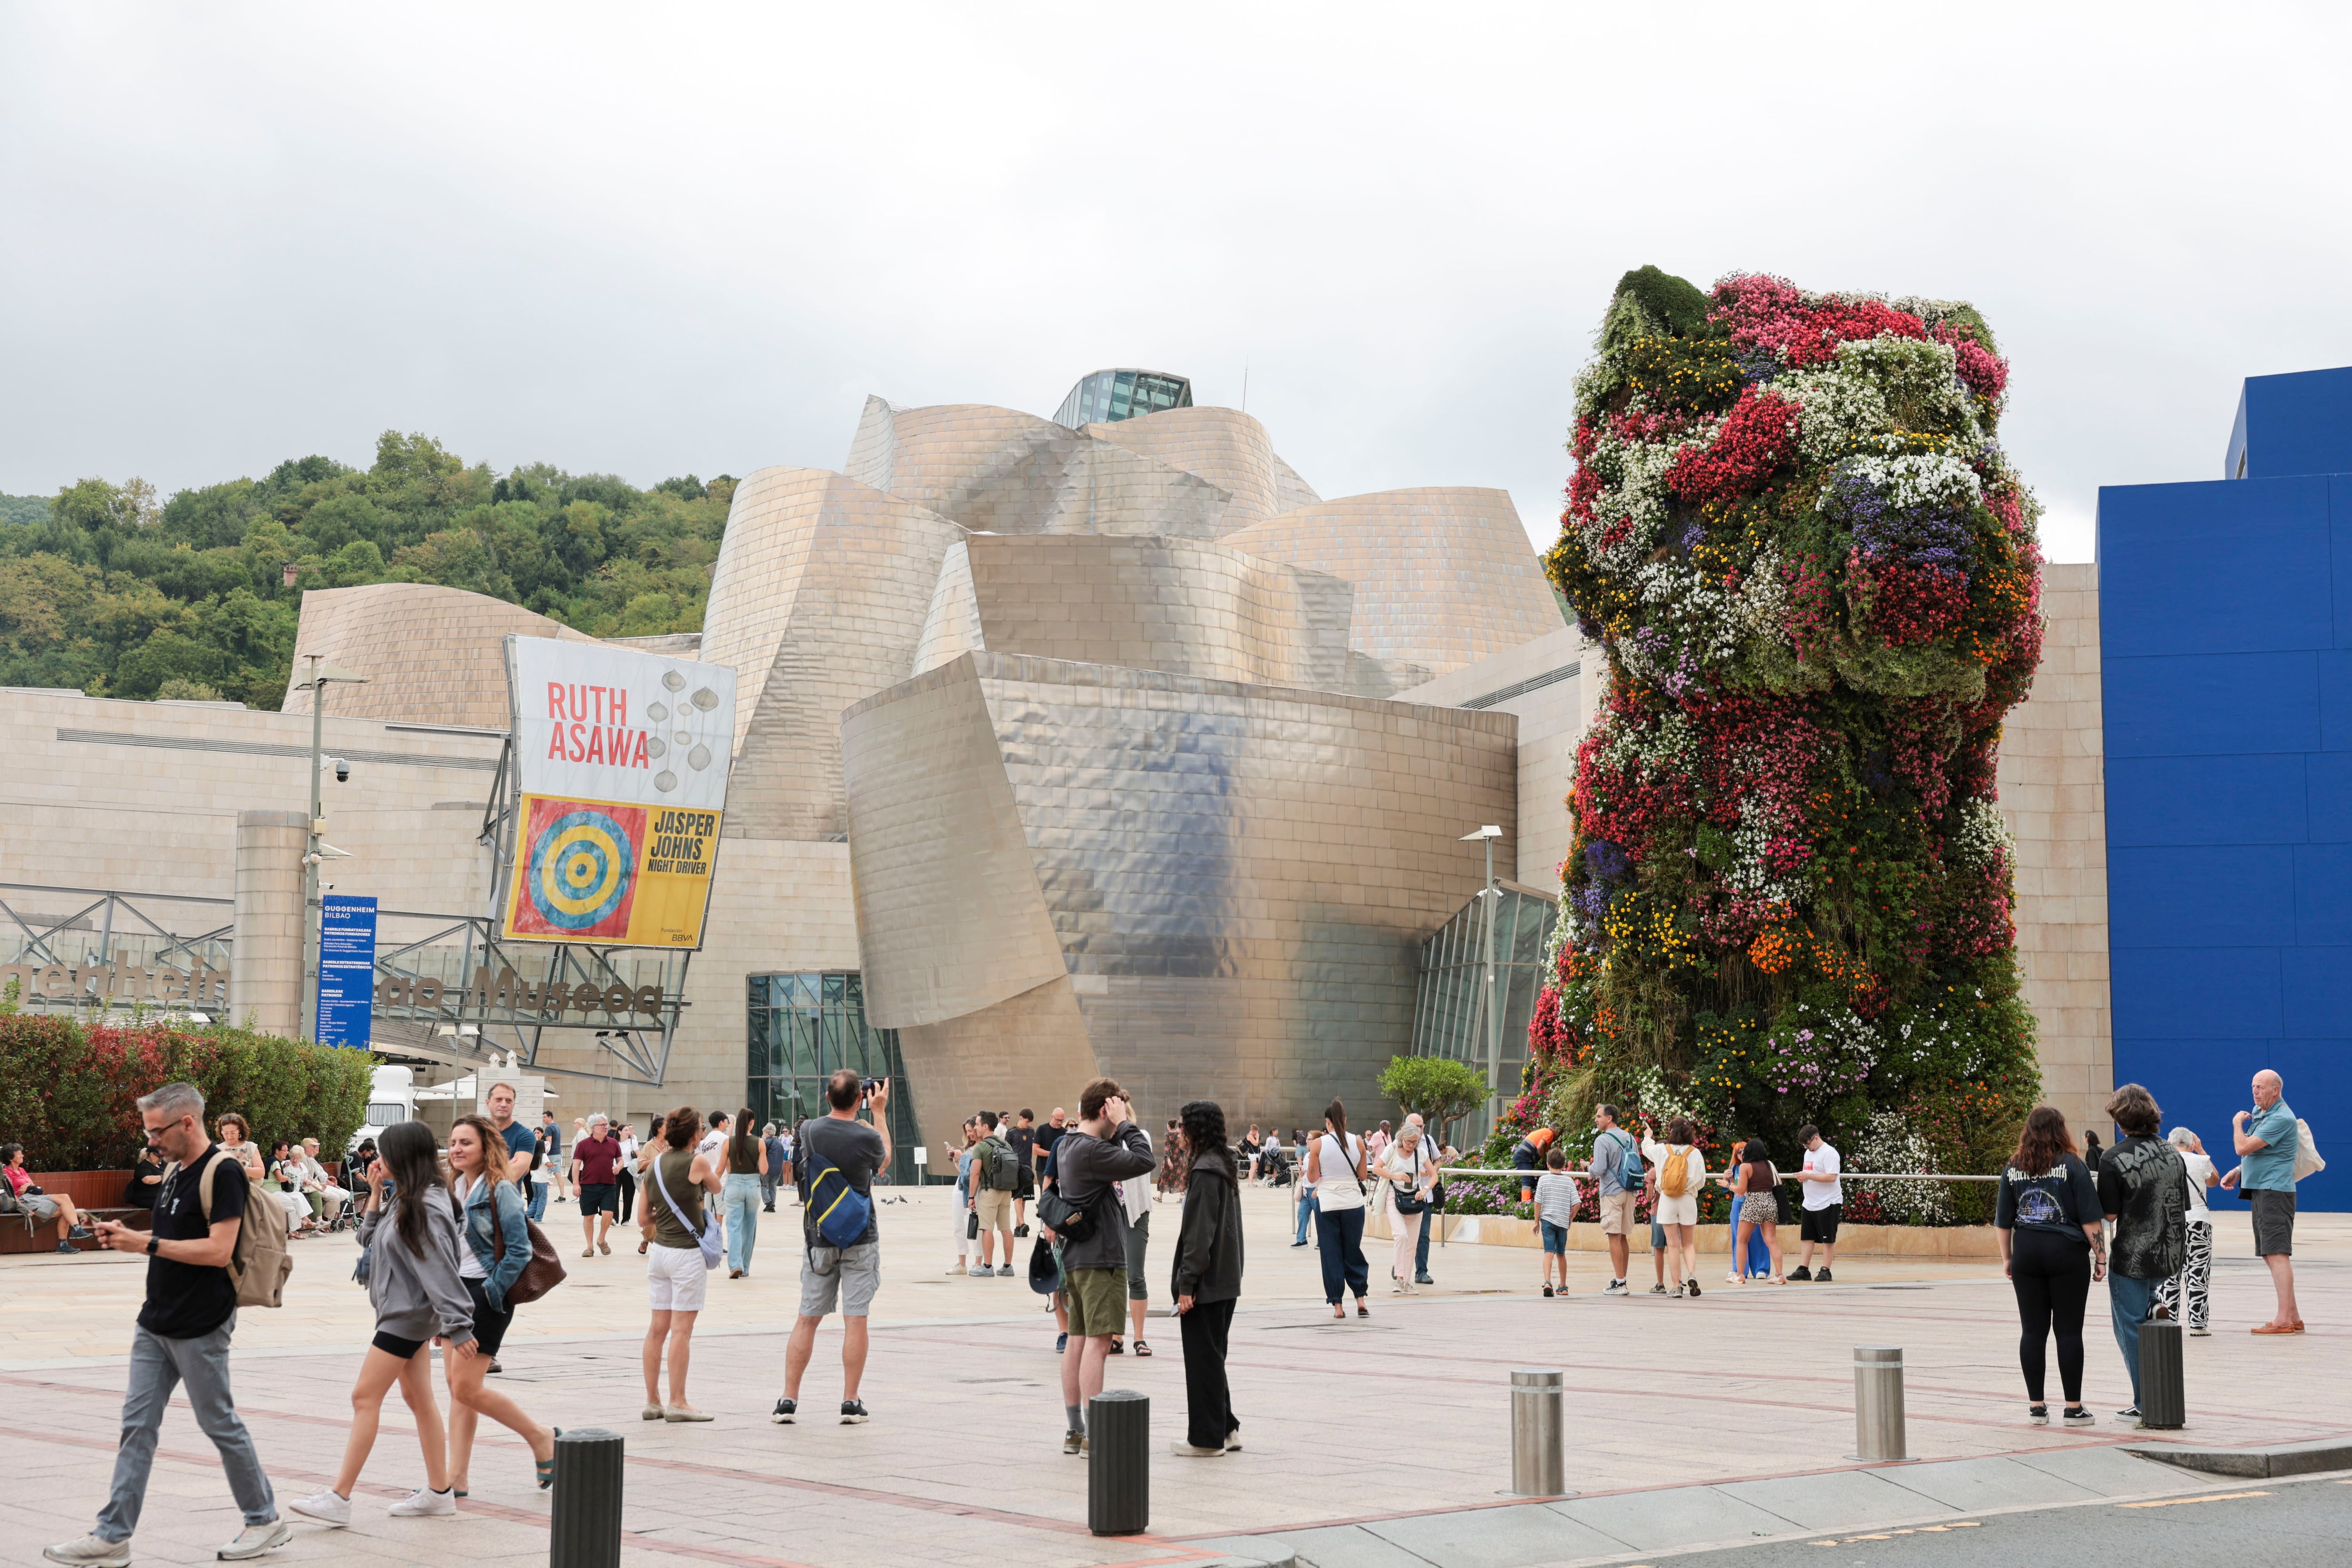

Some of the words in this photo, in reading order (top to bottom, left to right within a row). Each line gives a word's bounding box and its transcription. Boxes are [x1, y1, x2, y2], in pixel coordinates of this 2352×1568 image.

[548, 682, 627, 726] RUTH
[548, 722, 649, 769] ASAWA
[654, 811, 715, 837] JASPER
[651, 836, 703, 860] JOHNS
[648, 859, 674, 873] NIGHT
[676, 860, 707, 875] DRIVER
[467, 966, 664, 1014] Museoa
[2114, 1140, 2164, 1172] IRON
